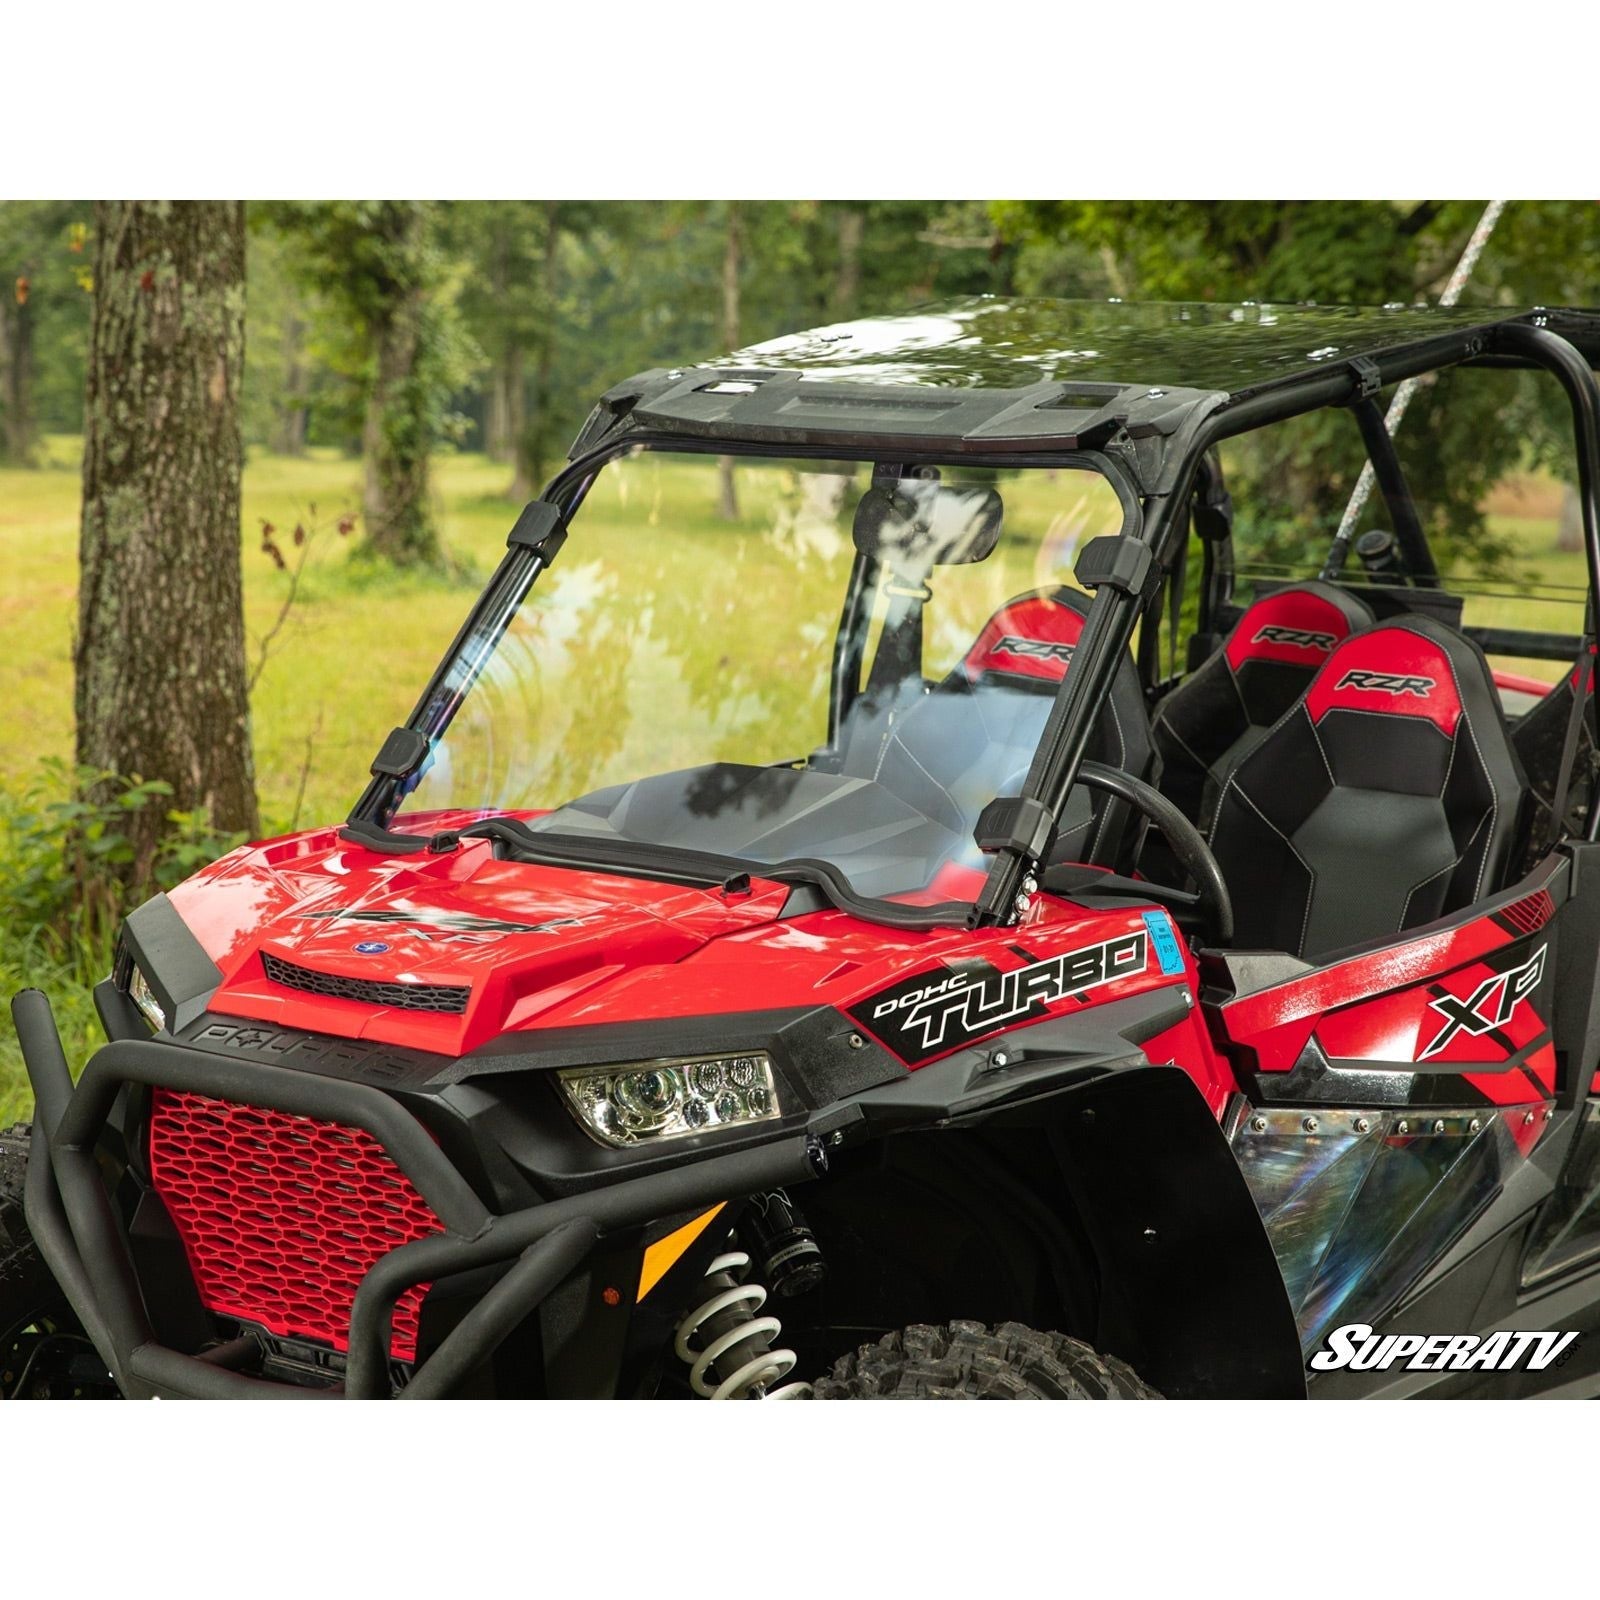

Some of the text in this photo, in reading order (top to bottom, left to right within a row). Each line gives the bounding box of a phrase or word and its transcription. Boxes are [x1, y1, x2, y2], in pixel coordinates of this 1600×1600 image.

[990, 635, 1076, 664] RZR
[1249, 624, 1339, 652] RZR
[1333, 669, 1437, 698] RZR
[873, 972, 968, 1019] DOHC
[900, 929, 1148, 1050] TURBO
[1415, 942, 1548, 1062] XP
